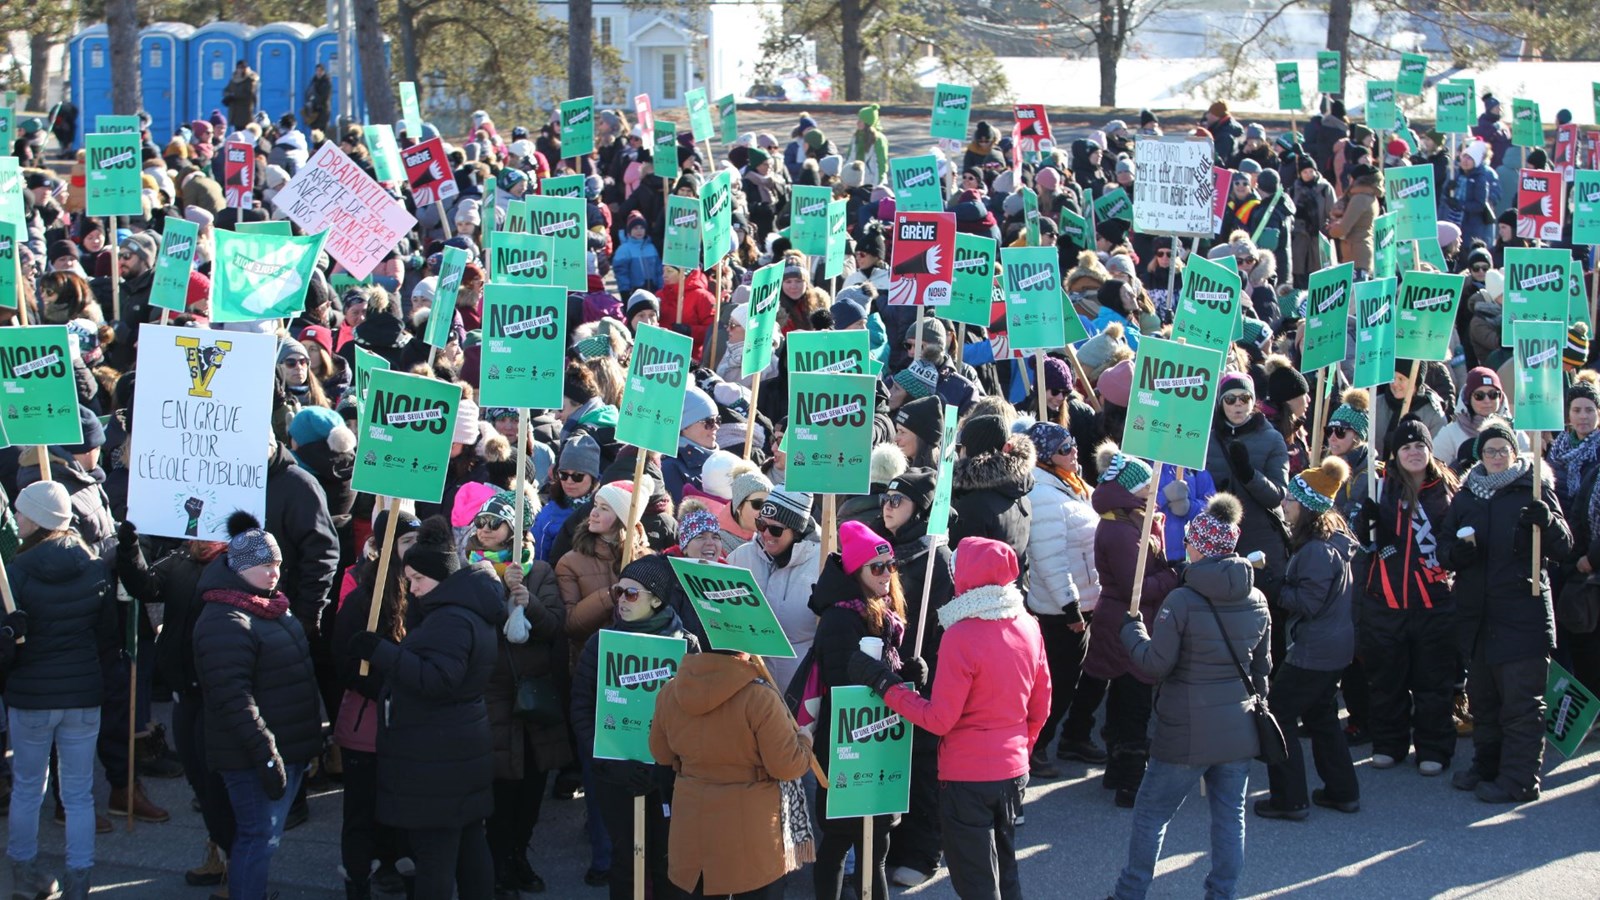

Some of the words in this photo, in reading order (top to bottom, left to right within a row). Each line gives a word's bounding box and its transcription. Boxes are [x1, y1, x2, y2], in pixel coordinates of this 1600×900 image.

[938, 92, 967, 110] NOUS
[563, 106, 591, 126] NOUS
[91, 147, 136, 170] NOUS
[896, 167, 935, 188] NOUS
[1390, 177, 1429, 200] NOUS
[1523, 178, 1546, 192] GRÈVE
[289, 198, 317, 225] NOS
[702, 184, 729, 221] NOUS
[795, 196, 826, 217] NOUS
[291, 176, 326, 209] AVEC
[364, 238, 388, 261] DE
[345, 198, 367, 219] DE
[361, 210, 397, 244] JOUER
[530, 210, 581, 239] NOUS
[669, 206, 698, 229] NOUS
[901, 222, 935, 240] GRÈVE
[164, 231, 192, 260] NOUS
[497, 247, 548, 279] NOUS
[955, 248, 990, 276] OUS
[1008, 263, 1055, 292] NOUS
[1510, 264, 1564, 292] NOUS
[750, 278, 780, 317] NOUS
[1186, 271, 1234, 314] NOUS
[1310, 280, 1347, 316] NOUS
[1403, 285, 1455, 312] NOUS
[490, 304, 558, 340] NOUS
[522, 319, 536, 329] SEULE
[539, 316, 550, 326] VOIX
[1360, 295, 1392, 329] NOUS
[0, 345, 66, 379] NOUS
[634, 343, 684, 388] NOUS
[795, 349, 862, 374] NOUS
[842, 359, 854, 367] VOIX
[1519, 339, 1558, 369] NOUS
[1140, 356, 1210, 401] NOUS
[1173, 378, 1187, 386] SEULE
[1189, 376, 1201, 384] VOIX
[162, 400, 188, 430] EN
[194, 399, 243, 432] GRÈVE
[371, 390, 450, 434] NOUS
[408, 412, 424, 420] SEULE
[427, 410, 440, 418] VOIX
[796, 392, 866, 427] NOUS
[829, 406, 844, 416] SEULE
[846, 403, 858, 413] VOIX
[181, 432, 220, 458] POUR
[138, 450, 190, 483] L'ÉCOLE
[198, 458, 264, 489] PUBLIQUE
[683, 573, 760, 607] NOUS
[638, 672, 654, 681] SEULE
[655, 669, 668, 677] VOIX
[838, 707, 905, 744] NOUS
[1546, 683, 1589, 742] NOUS
